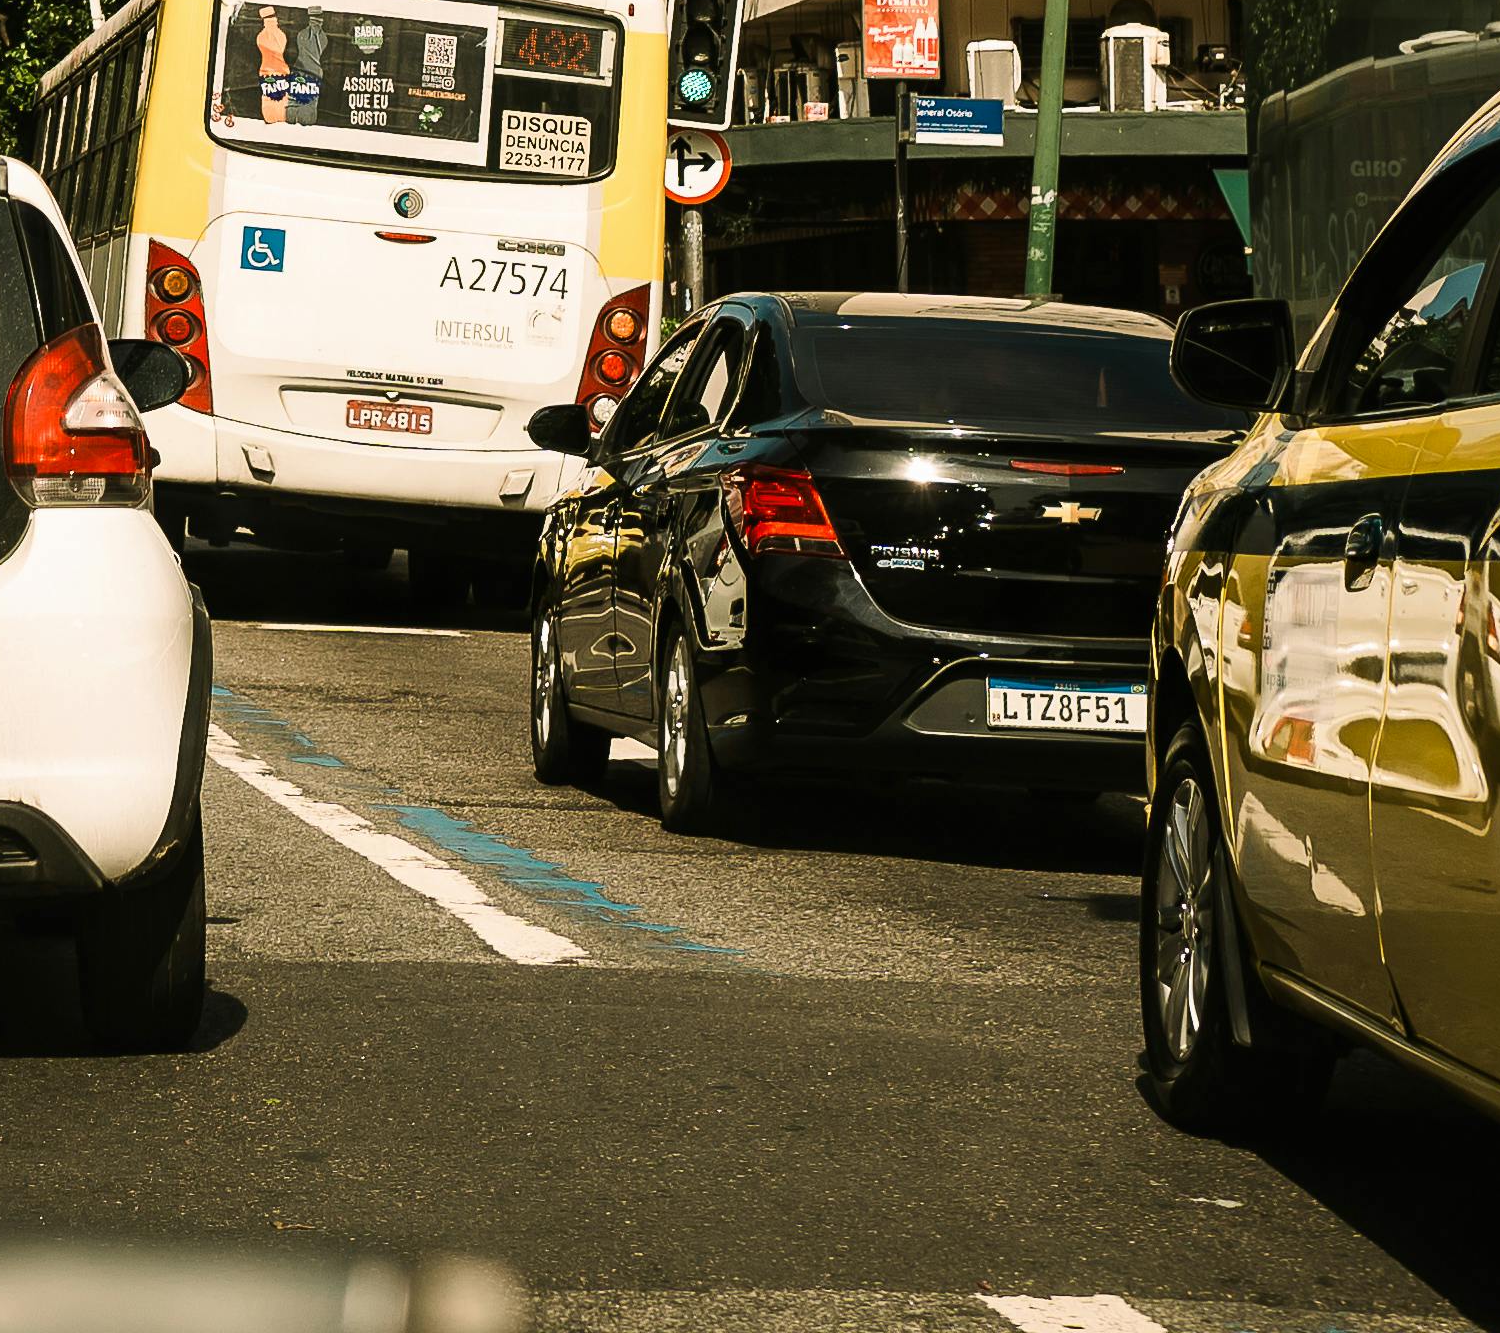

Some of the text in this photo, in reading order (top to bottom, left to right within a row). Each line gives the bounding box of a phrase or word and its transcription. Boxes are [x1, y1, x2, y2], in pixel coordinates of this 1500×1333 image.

[519, 27, 591, 72] 432
[360, 61, 378, 76] ME
[343, 76, 394, 93] ASSUSTA
[349, 93, 388, 110] QUE EU
[350, 109, 387, 126] GOSTO
[507, 115, 588, 136] DISQUE
[506, 134, 585, 154] DENÚNCIA
[505, 151, 585, 171] 2253-1177
[1351, 160, 1401, 177] GIRO
[440, 256, 568, 300] A27574
[435, 319, 513, 344] INTERSUL
[1002, 692, 1129, 725] LTZ8F51
